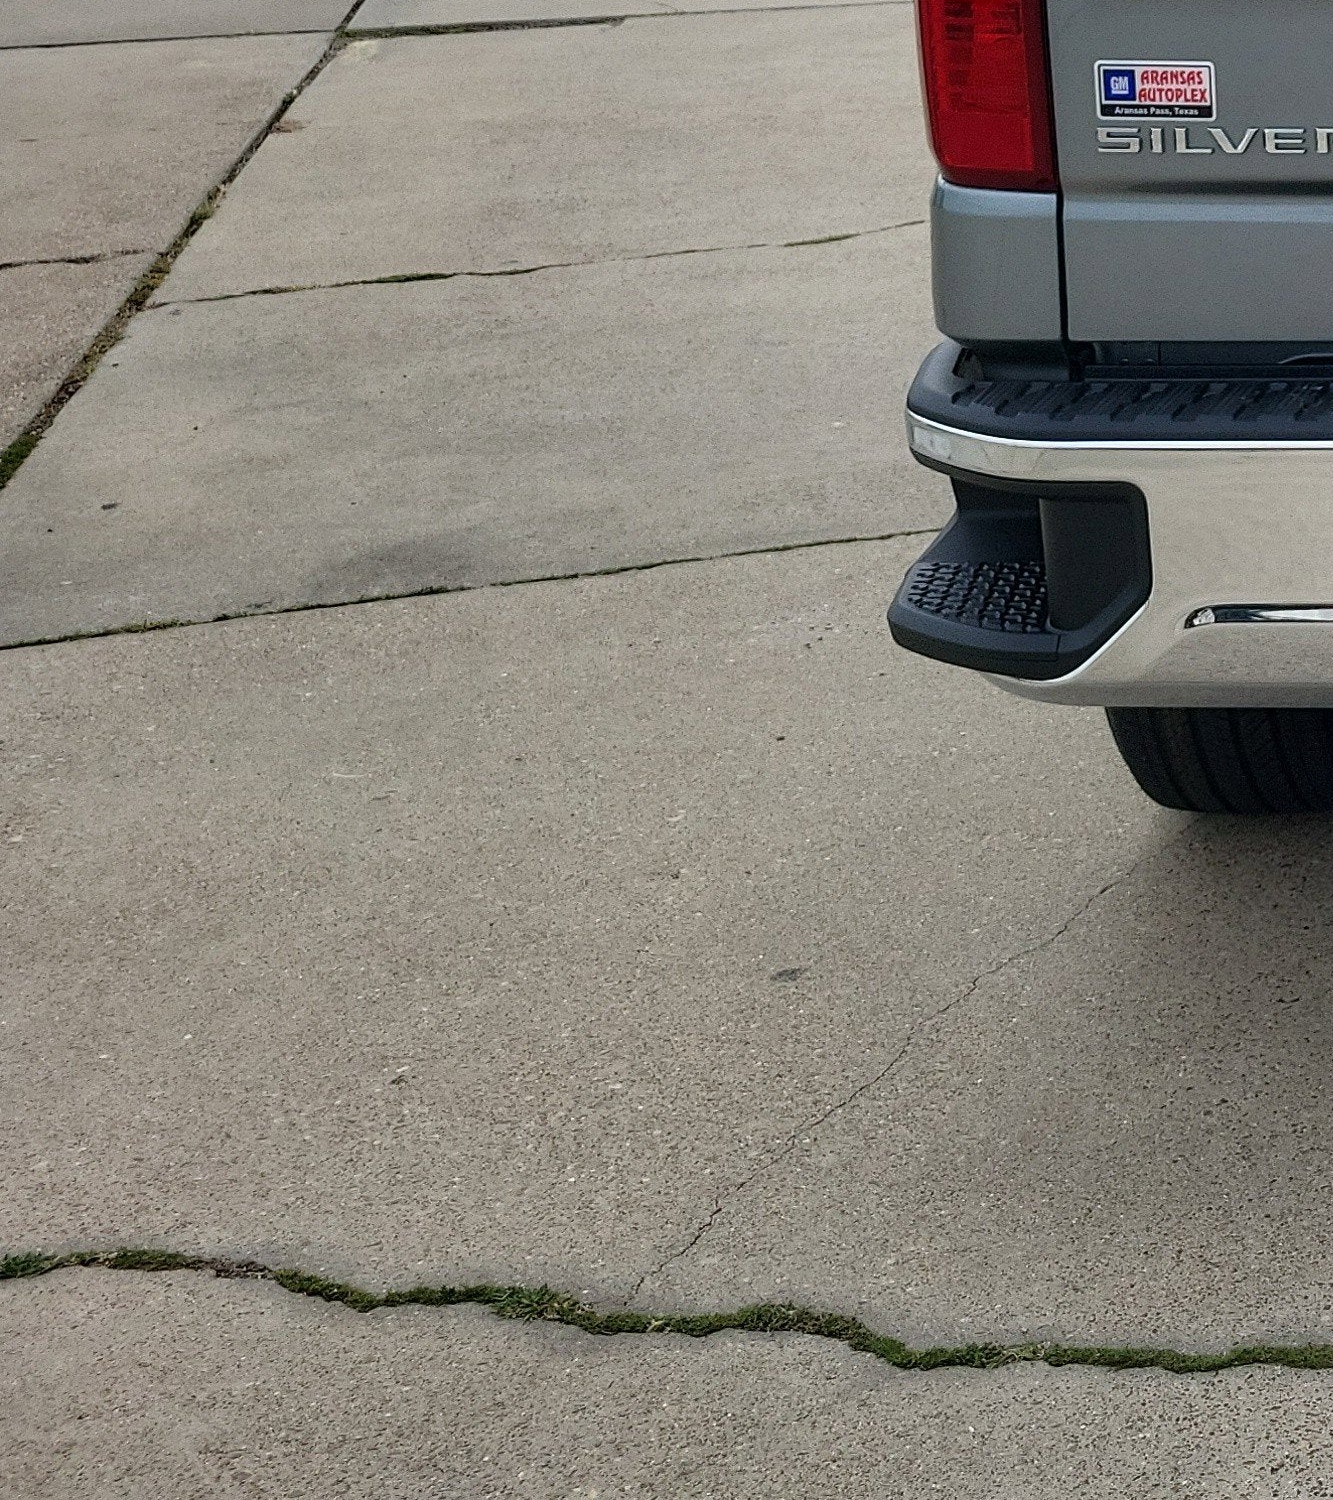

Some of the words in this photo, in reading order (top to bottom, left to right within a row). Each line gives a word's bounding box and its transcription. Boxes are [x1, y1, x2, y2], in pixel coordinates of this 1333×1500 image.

[1110, 76, 1129, 94] GM
[1140, 70, 1203, 86] ARANSAS
[1138, 87, 1207, 103] AUTOPLEX
[1114, 106, 1149, 115] Aransas
[1150, 106, 1173, 116] Pass,
[1174, 107, 1199, 116] Texas
